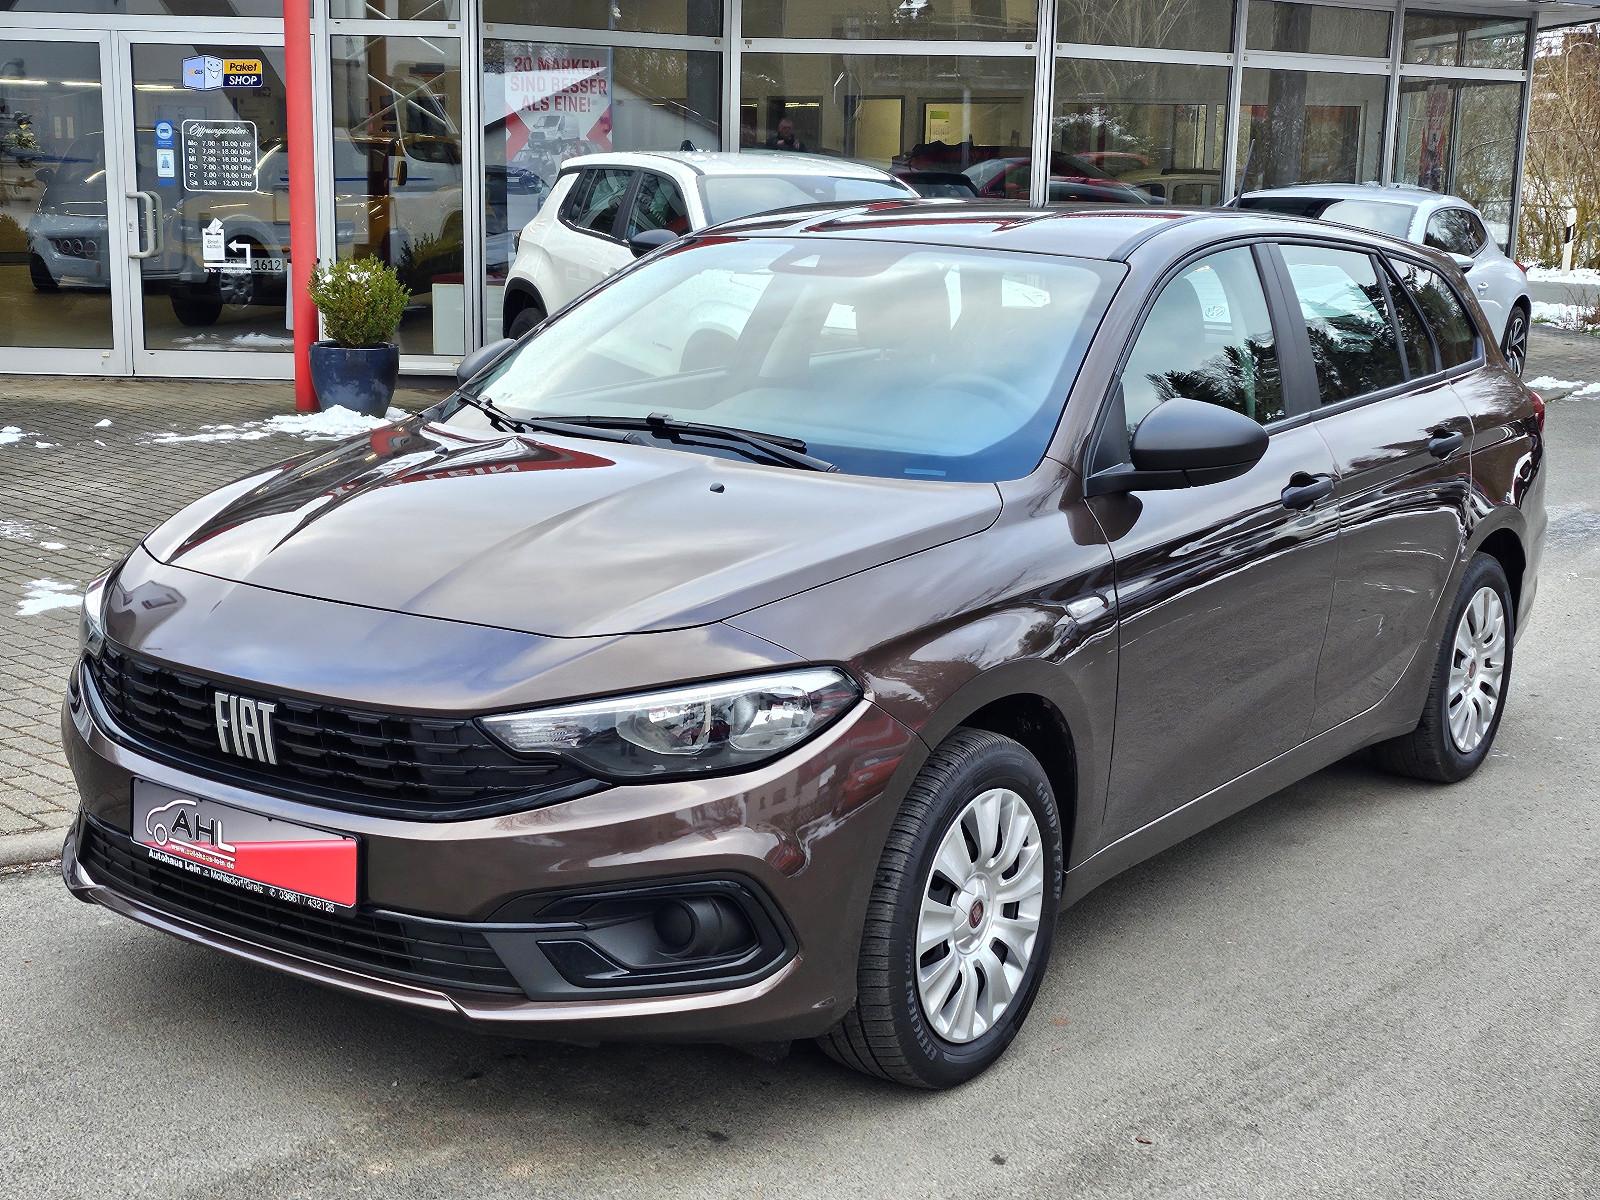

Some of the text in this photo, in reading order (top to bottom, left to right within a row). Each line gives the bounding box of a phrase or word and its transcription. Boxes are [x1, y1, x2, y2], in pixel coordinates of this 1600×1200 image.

[229, 62, 258, 72] Paket
[513, 56, 600, 75] 20 MARKEN
[229, 75, 258, 85] SHOP
[511, 76, 607, 95] SIND BESSER
[521, 94, 591, 113] ALS EINE!
[254, 259, 282, 271] 1612
[214, 691, 277, 765] FIAT
[171, 808, 236, 853] AHL
[149, 849, 183, 869] Autohaus
[184, 859, 201, 875] Lein
[279, 889, 301, 905] 03661
[307, 898, 335, 913] 432125
